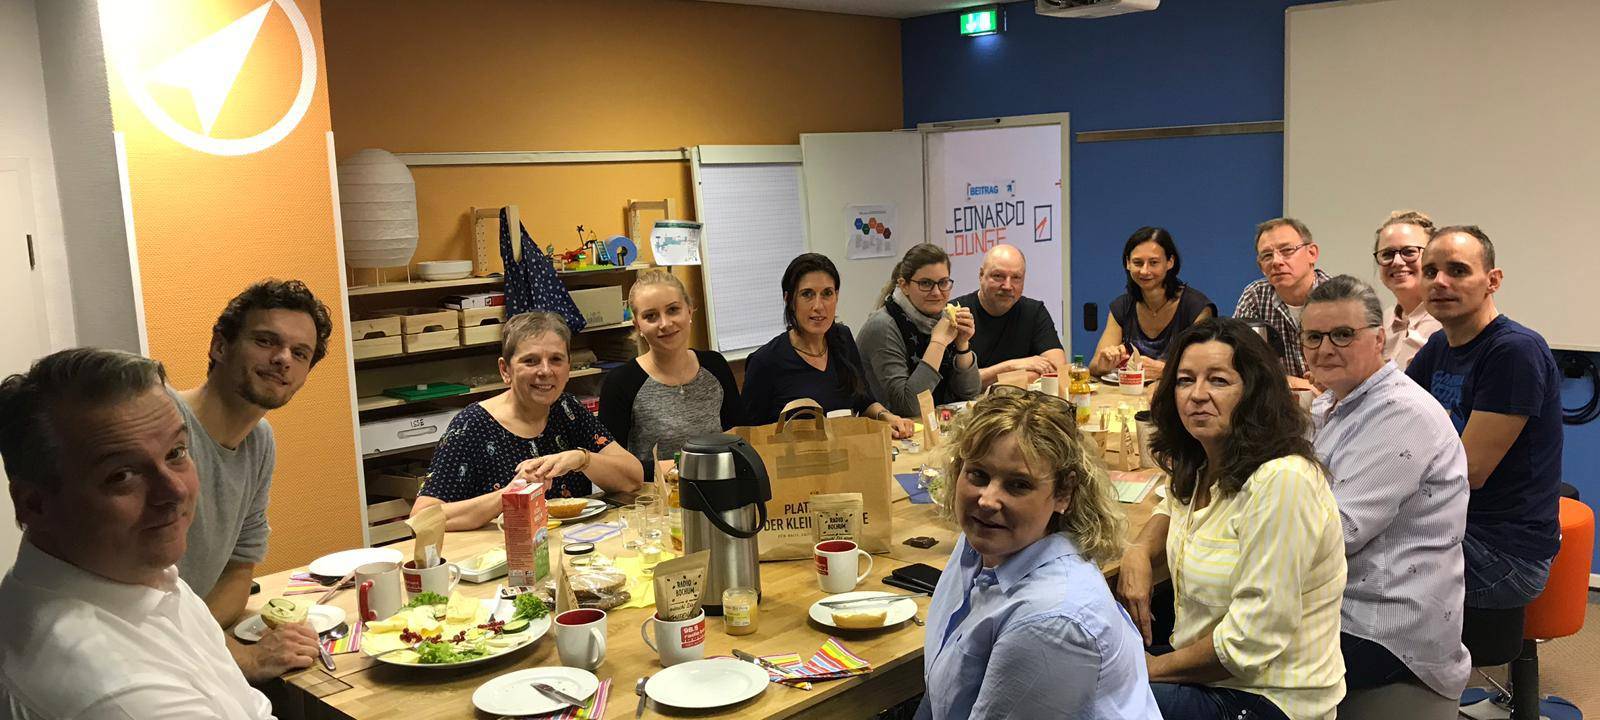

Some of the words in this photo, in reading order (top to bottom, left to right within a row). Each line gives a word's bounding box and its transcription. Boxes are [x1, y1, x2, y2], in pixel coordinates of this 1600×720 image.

[970, 186, 999, 195] BEITRAG
[784, 502, 811, 515] PLAT
[763, 518, 784, 531] DER
[786, 516, 812, 530] KLEI
[676, 579, 692, 588] RADIO
[676, 587, 695, 597] BOCHUM
